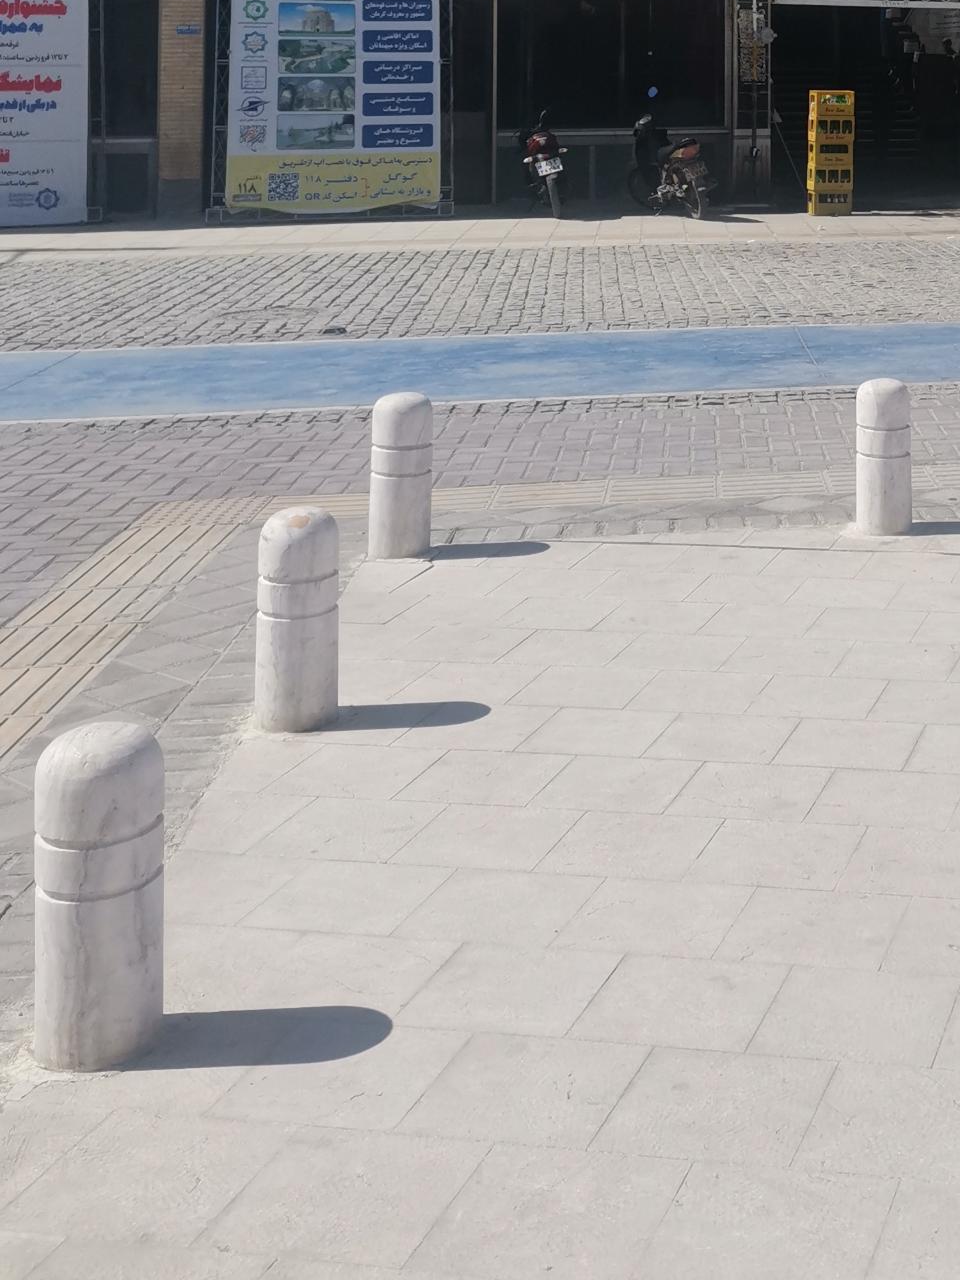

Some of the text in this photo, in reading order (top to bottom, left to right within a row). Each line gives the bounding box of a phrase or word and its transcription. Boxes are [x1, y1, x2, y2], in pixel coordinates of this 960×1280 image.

[28, 22, 44, 33] به
[402, 157, 432, 167] دسترسی
[325, 175, 358, 186] دفتر
[382, 172, 418, 184] گوگل
[237, 182, 257, 195] ۱۱۸
[305, 192, 320, 201] QR
